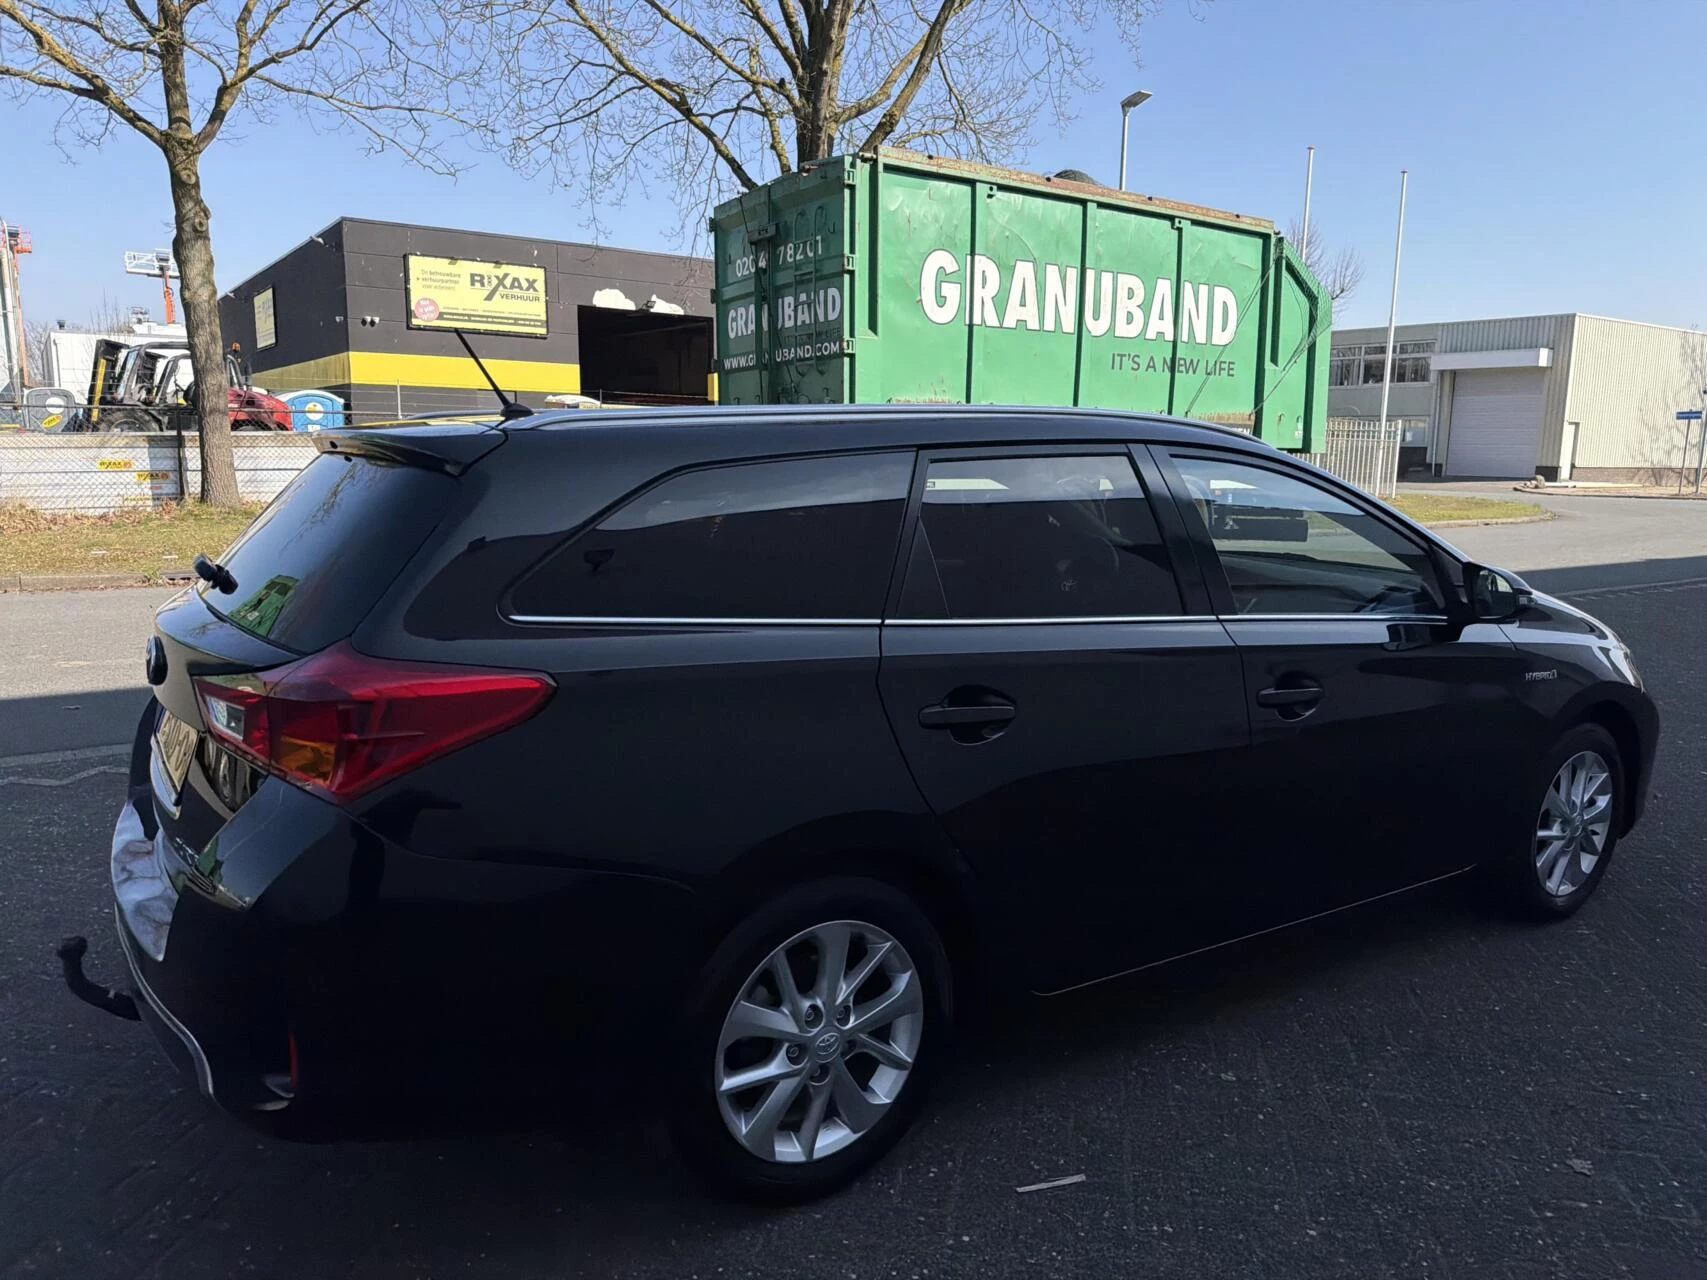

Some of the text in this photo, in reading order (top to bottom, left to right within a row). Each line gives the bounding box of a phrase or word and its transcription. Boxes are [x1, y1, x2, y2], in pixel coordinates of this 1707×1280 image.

[499, 293, 540, 303] VERHUUR
[919, 248, 1238, 347] GRANUBAND
[1110, 353, 1236, 377] IT'S A NEW LIFE
